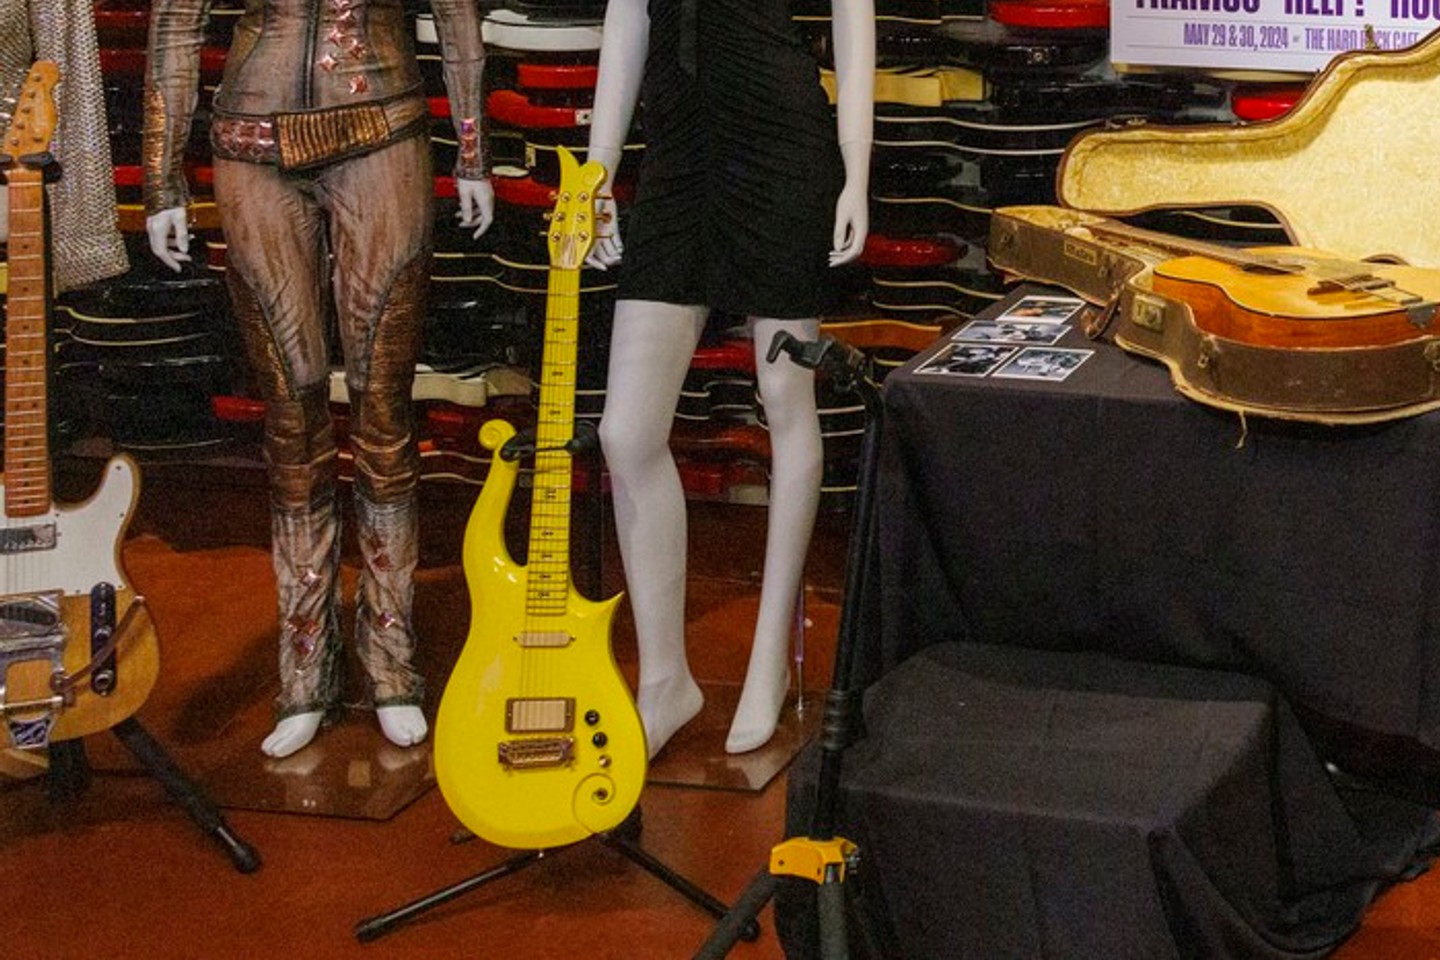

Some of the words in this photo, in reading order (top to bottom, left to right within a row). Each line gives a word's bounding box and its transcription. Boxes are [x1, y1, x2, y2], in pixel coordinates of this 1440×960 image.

[1183, 23, 1210, 46] MAY
[1212, 24, 1225, 46] 29
[1229, 24, 1237, 47] &
[1239, 25, 1258, 50] 30,
[1260, 26, 1289, 48] 2024
[1304, 28, 1325, 50] THE
[1327, 29, 1357, 51] HARD
[1360, 30, 1390, 50] CK
